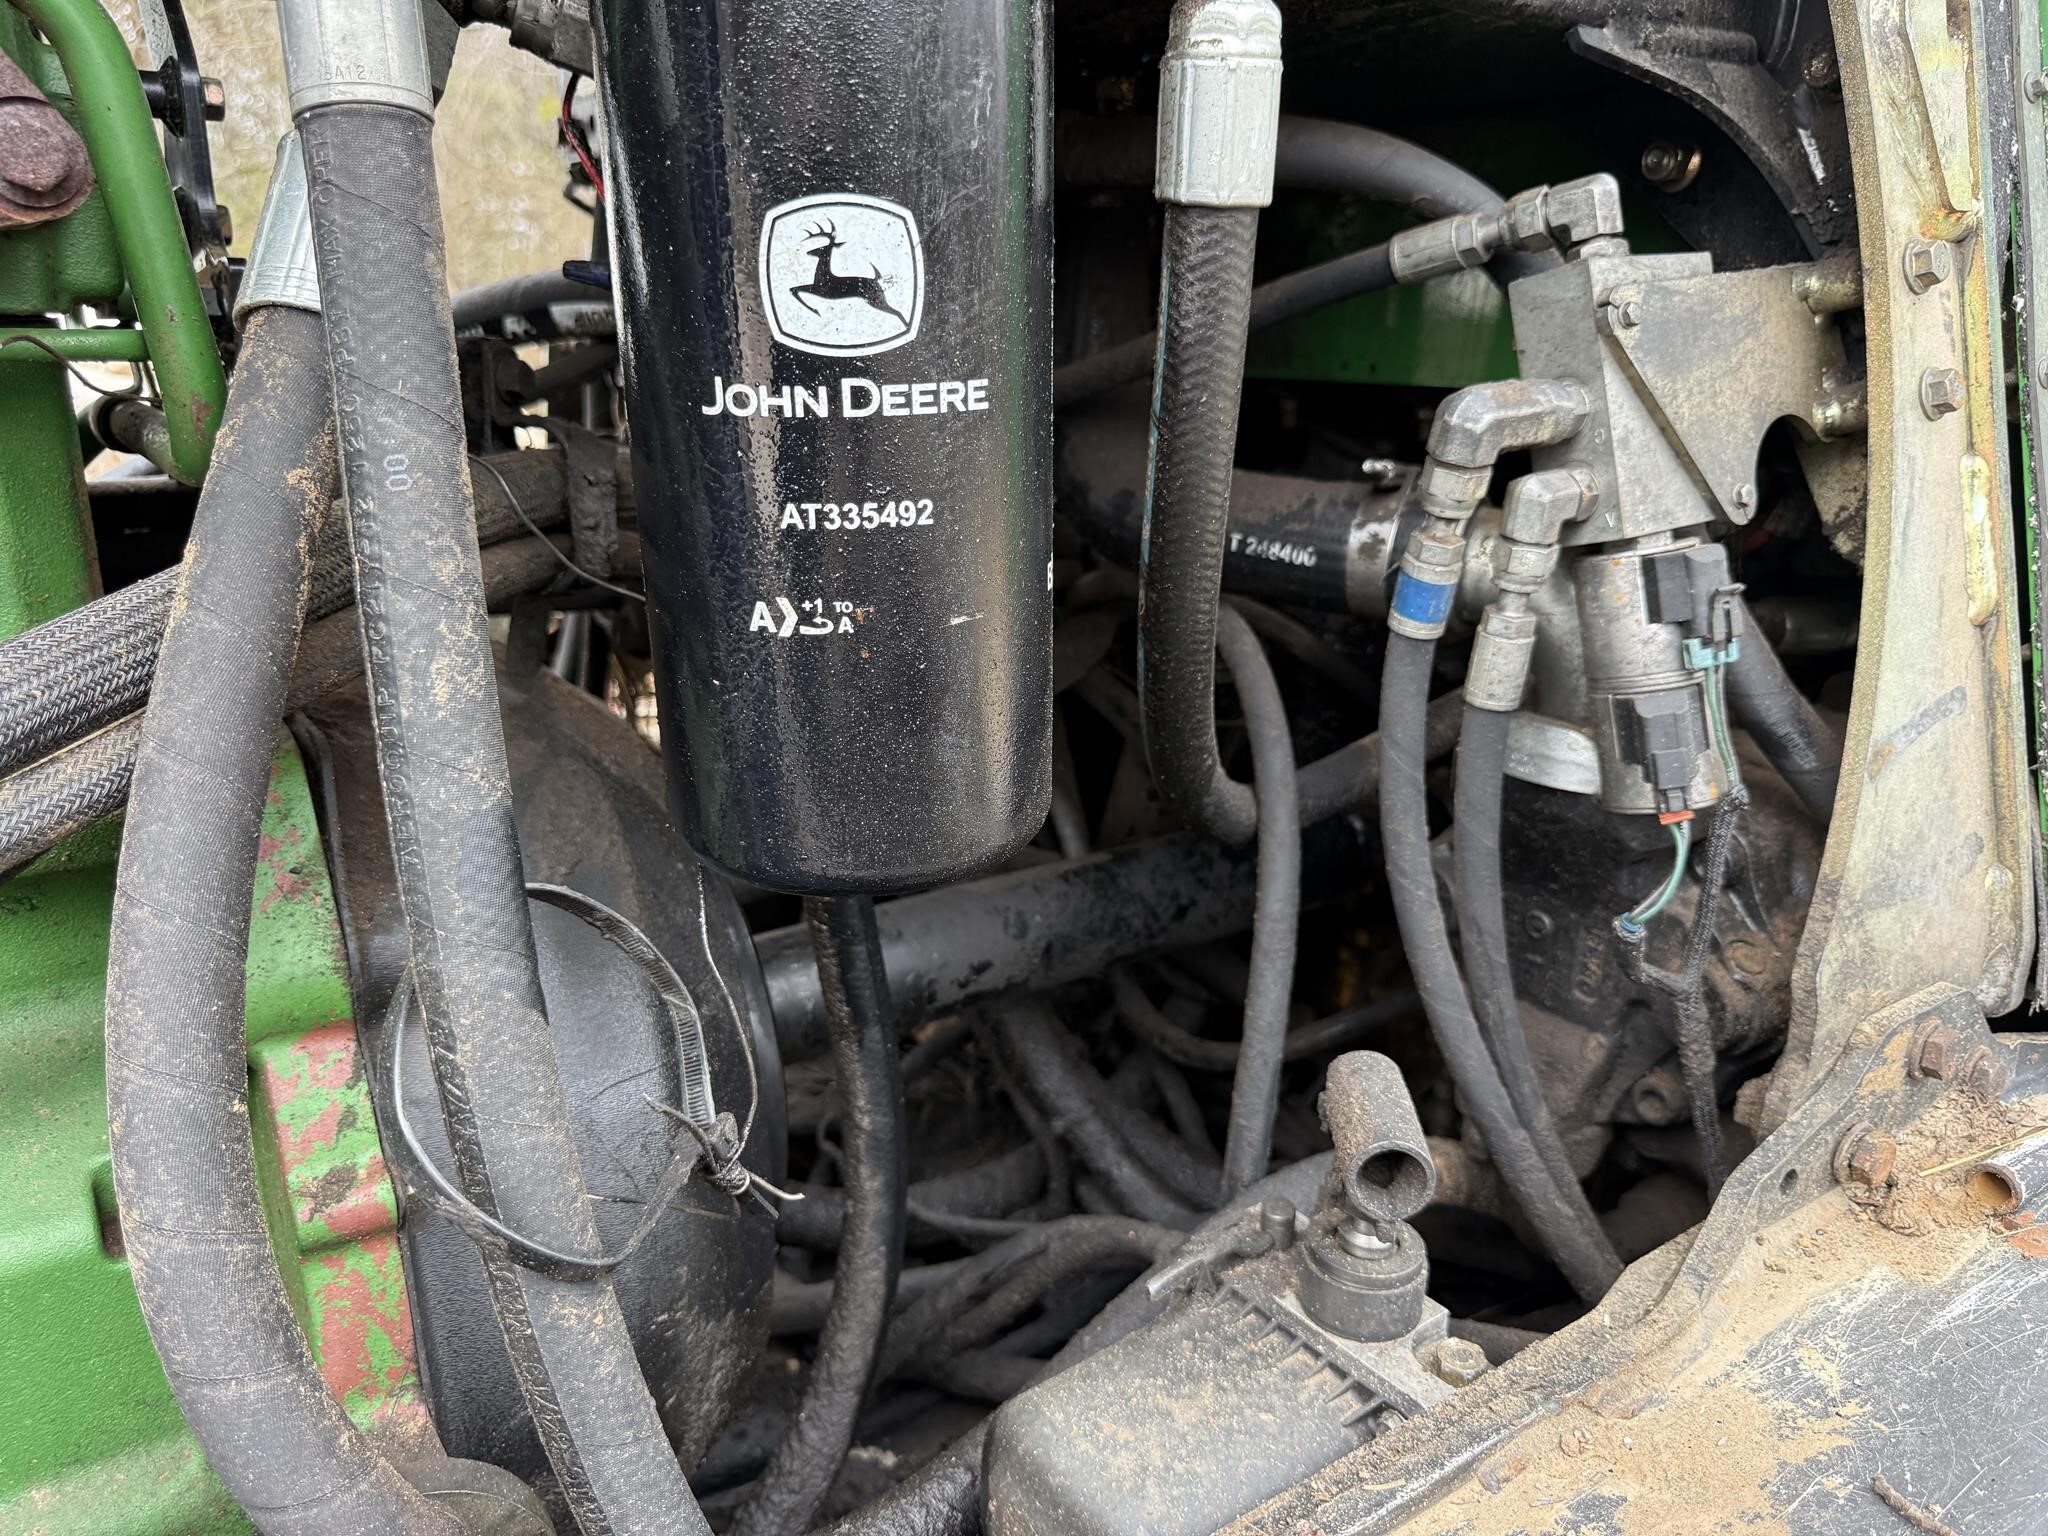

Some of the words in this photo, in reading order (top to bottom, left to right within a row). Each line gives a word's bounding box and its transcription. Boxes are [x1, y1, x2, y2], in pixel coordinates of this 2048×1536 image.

[311, 127, 336, 204] OPER
[320, 216, 345, 279] MAX
[702, 376, 829, 418] JOHN
[841, 377, 990, 418] DEERE
[780, 499, 934, 530] AT335492
[749, 600, 778, 634] A
[832, 601, 854, 613] TO
[838, 615, 855, 634] A
